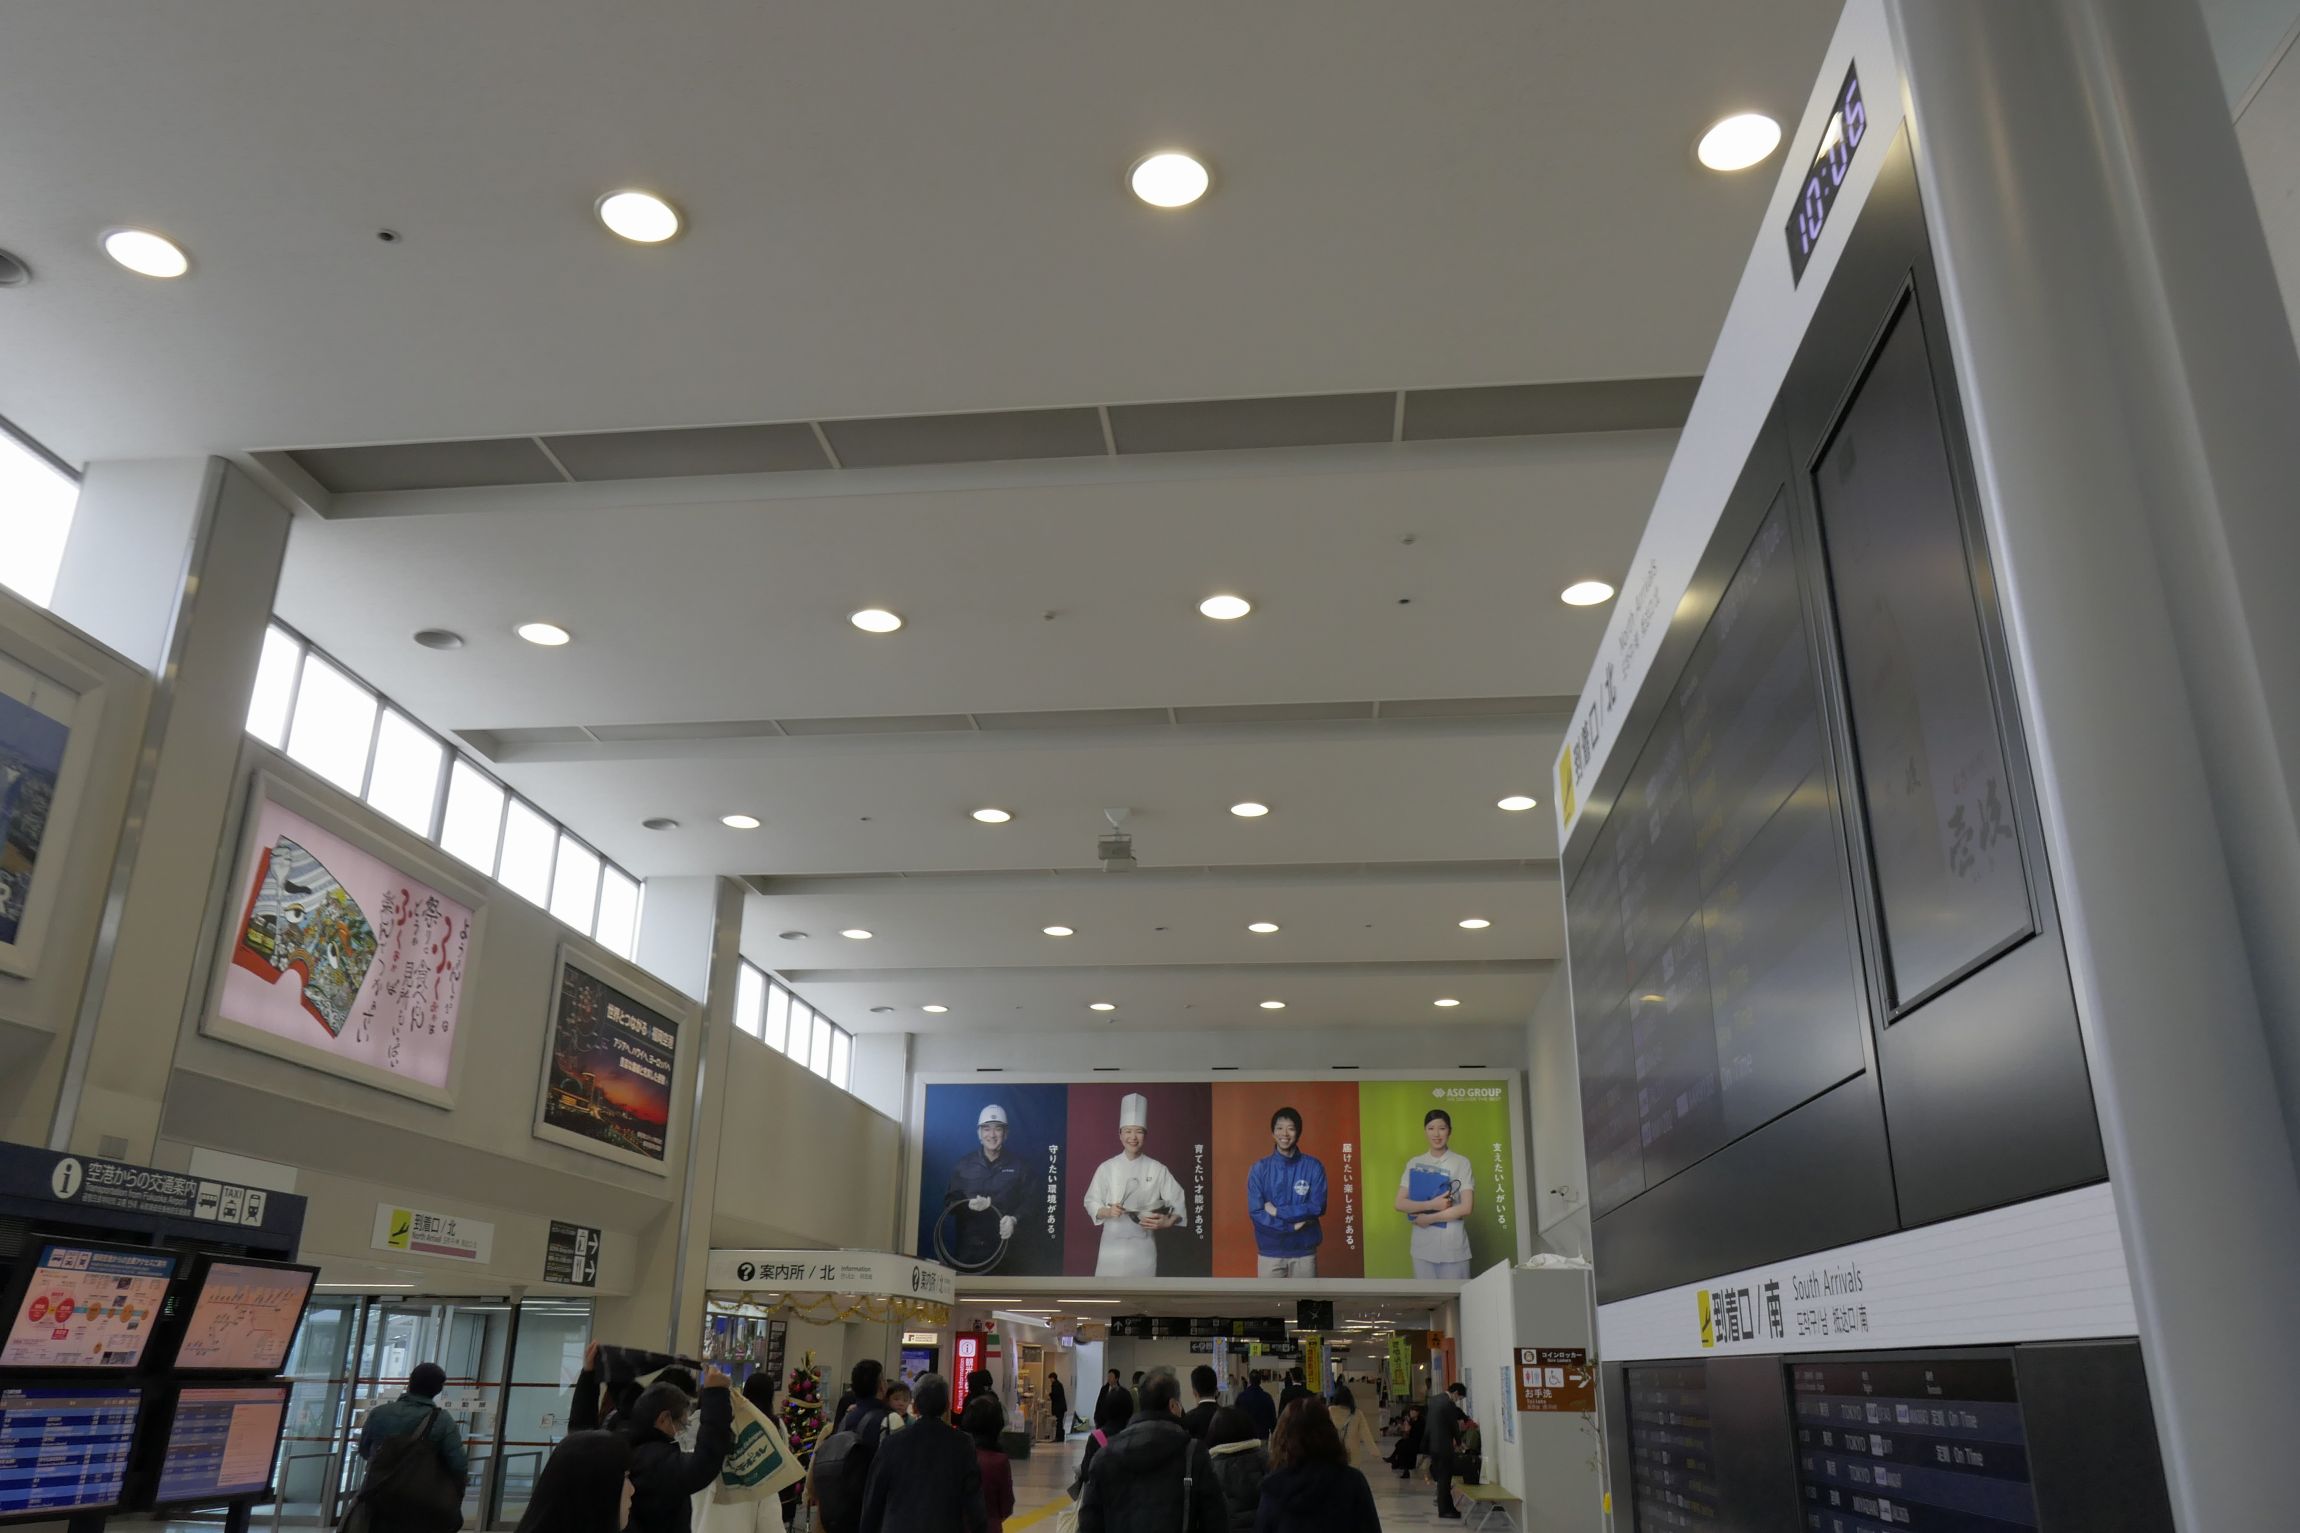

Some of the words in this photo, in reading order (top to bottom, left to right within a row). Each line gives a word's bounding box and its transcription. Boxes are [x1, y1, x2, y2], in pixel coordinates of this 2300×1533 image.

[1799, 79, 1866, 255] 10:06
[1446, 1088, 1466, 1097] ASO
[1467, 1087, 1502, 1097] GROUP
[86, 1162, 198, 1199] 空港からの交通案内
[1492, 1143, 1508, 1230] 支えたい人がいる。
[224, 1187, 244, 1199] TAXI
[1047, 1144, 1059, 1239] 守りたい環境がある。
[1194, 1144, 1205, 1240] 育てたい才能がある。
[1342, 1143, 1356, 1250] 届けたい楽しさがある。
[1792, 1269, 1821, 1301] South
[1823, 1261, 1863, 1298] Arrivals
[1541, 1351, 1583, 1359] コインロッカー
[1525, 1388, 1552, 1399] お手洗
[1841, 1403, 1862, 1422] TOKYO
[1948, 1411, 1959, 1427] On
[1959, 1411, 1979, 1430] Time
[1845, 1434, 1867, 1453] TOKYO
[1952, 1446, 1966, 1464] On
[1964, 1447, 1985, 1468] Time
[1848, 1464, 1872, 1484] TOKYO
